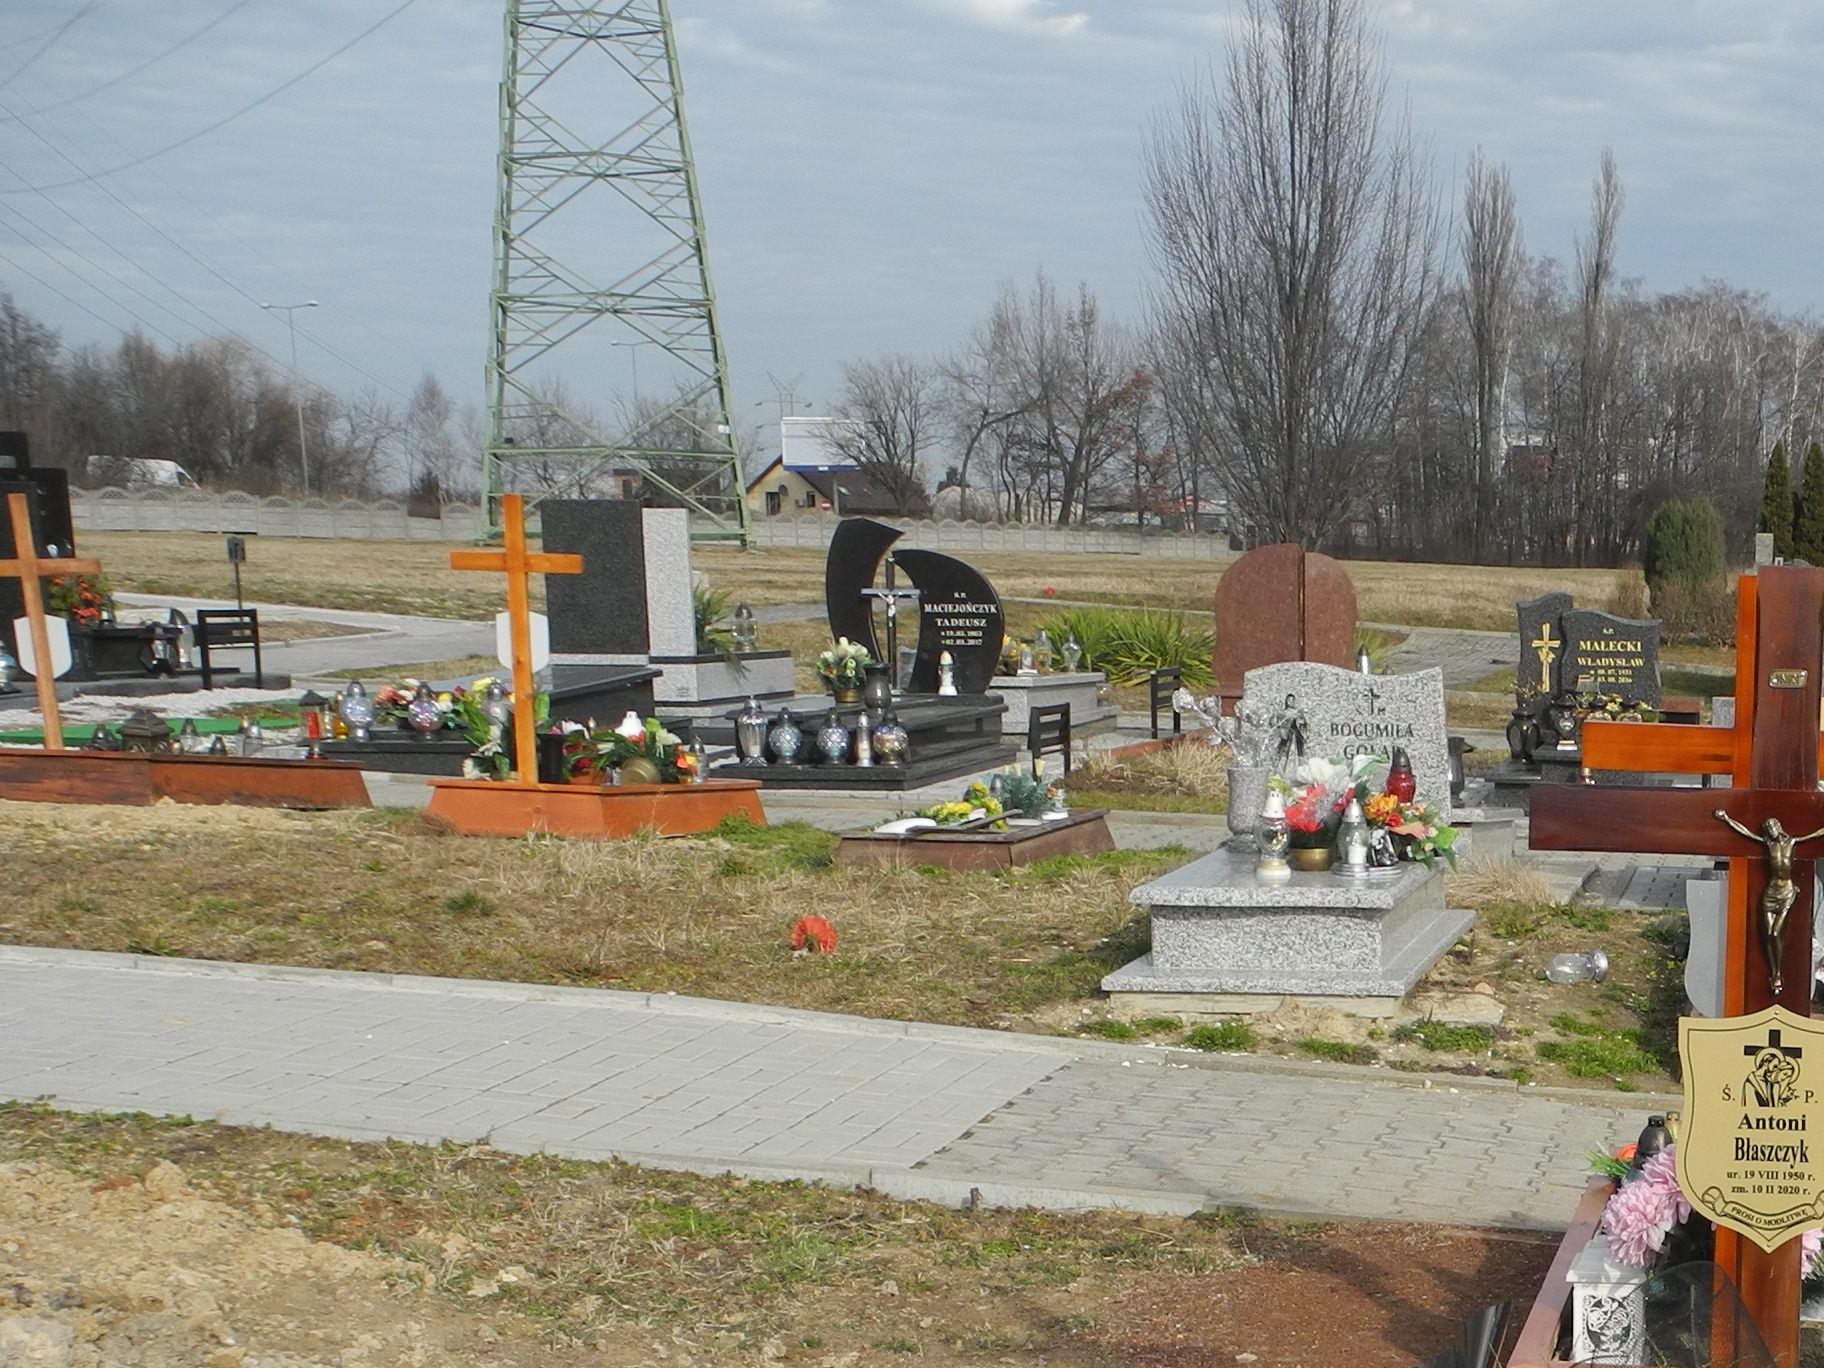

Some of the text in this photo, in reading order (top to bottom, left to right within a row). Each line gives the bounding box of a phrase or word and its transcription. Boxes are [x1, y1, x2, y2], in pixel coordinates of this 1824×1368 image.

[924, 602, 997, 614] MACIEJOŃCZYK
[935, 618, 987, 627] TADEUSZ
[1578, 640, 1642, 652] MALECKI
[1737, 1113, 1807, 1132] Antoni
[1734, 1136, 1809, 1169] Błaszczyk
[1726, 1170, 1816, 1182] ur. 19 VIII 1950 r.
[1731, 1184, 1811, 1196] zm. 10 II 2020 r.
[1731, 1206, 1755, 1222] PROSI
[1755, 1217, 1762, 1225] O
